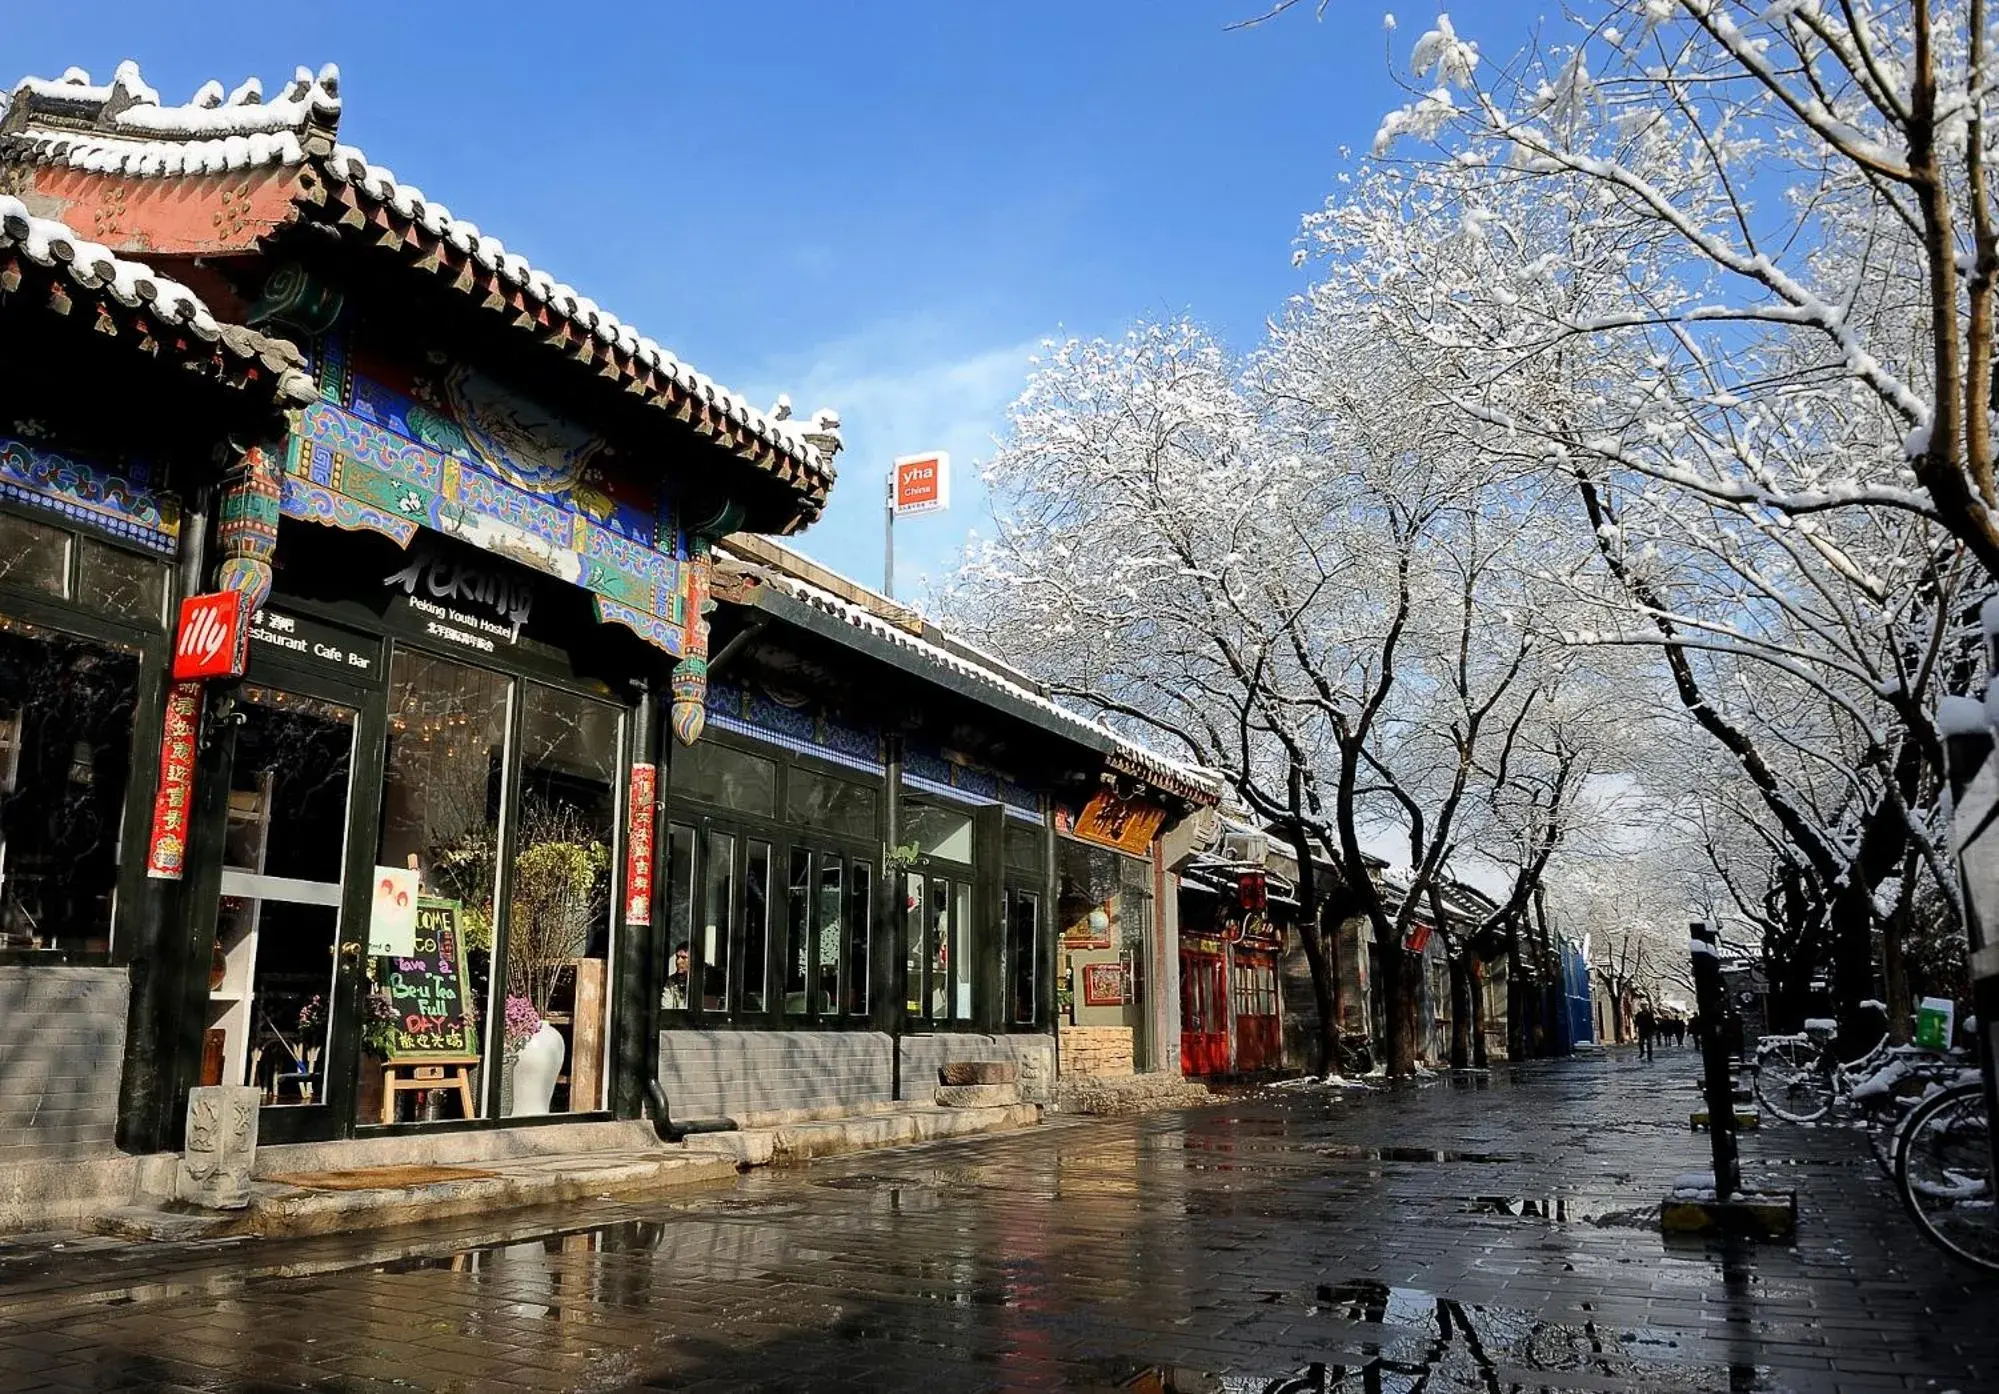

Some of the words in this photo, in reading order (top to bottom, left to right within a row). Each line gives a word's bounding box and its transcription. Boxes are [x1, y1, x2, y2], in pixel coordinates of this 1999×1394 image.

[903, 467, 932, 485] yha
[409, 595, 446, 619] Peking
[449, 607, 478, 628] Youth
[480, 620, 512, 639] Hostel
[178, 606, 228, 667] illy
[314, 643, 343, 662] Cafe
[348, 652, 371, 669] Bar
[439, 960, 453, 974] a
[417, 998, 448, 1017] Full
